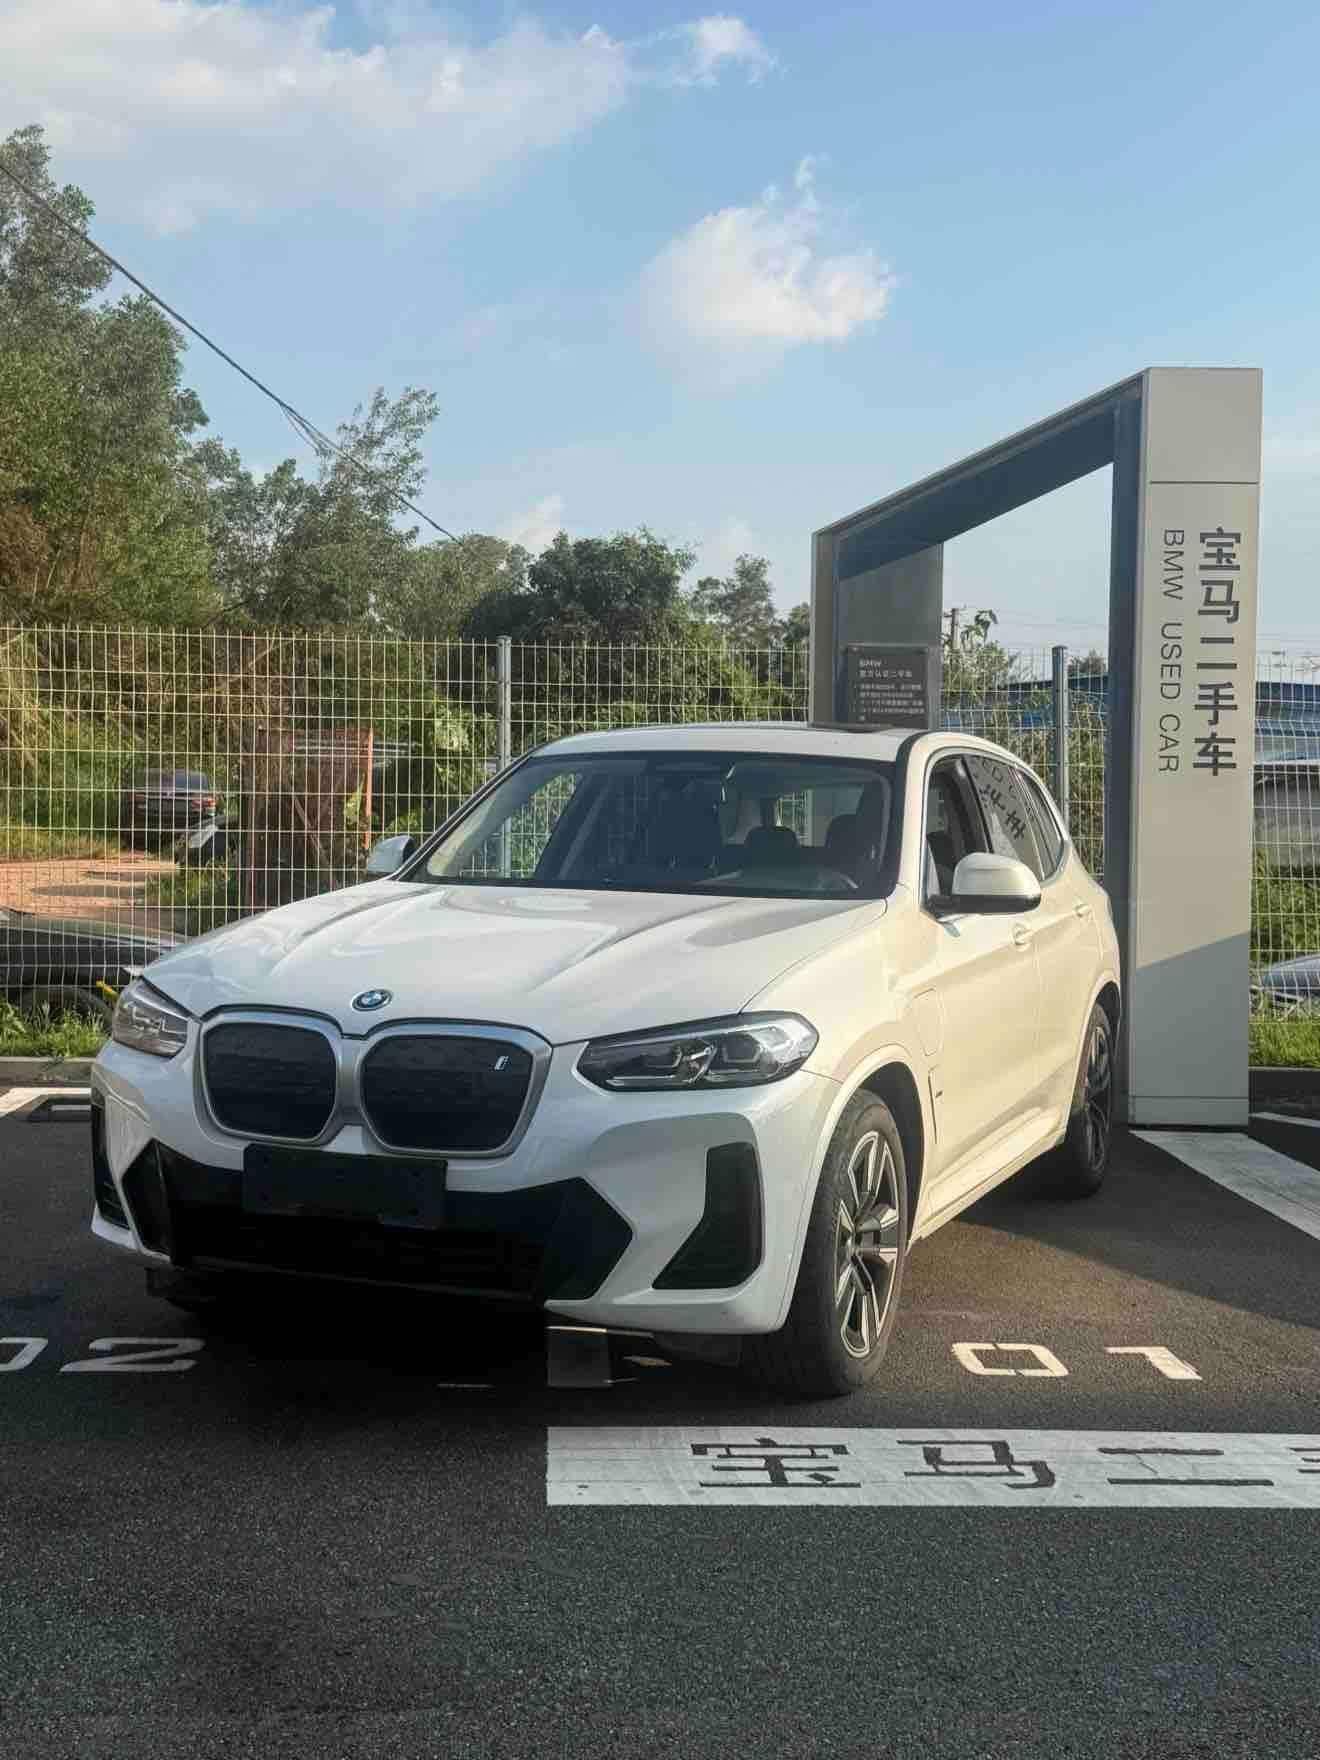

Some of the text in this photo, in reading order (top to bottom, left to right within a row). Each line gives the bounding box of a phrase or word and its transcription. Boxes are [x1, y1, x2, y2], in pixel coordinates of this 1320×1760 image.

[1158, 529, 1185, 774] BMW USED CAR
[1193, 527, 1241, 776] 宝马二手车
[690, 1437, 1320, 1488] 宝马二
